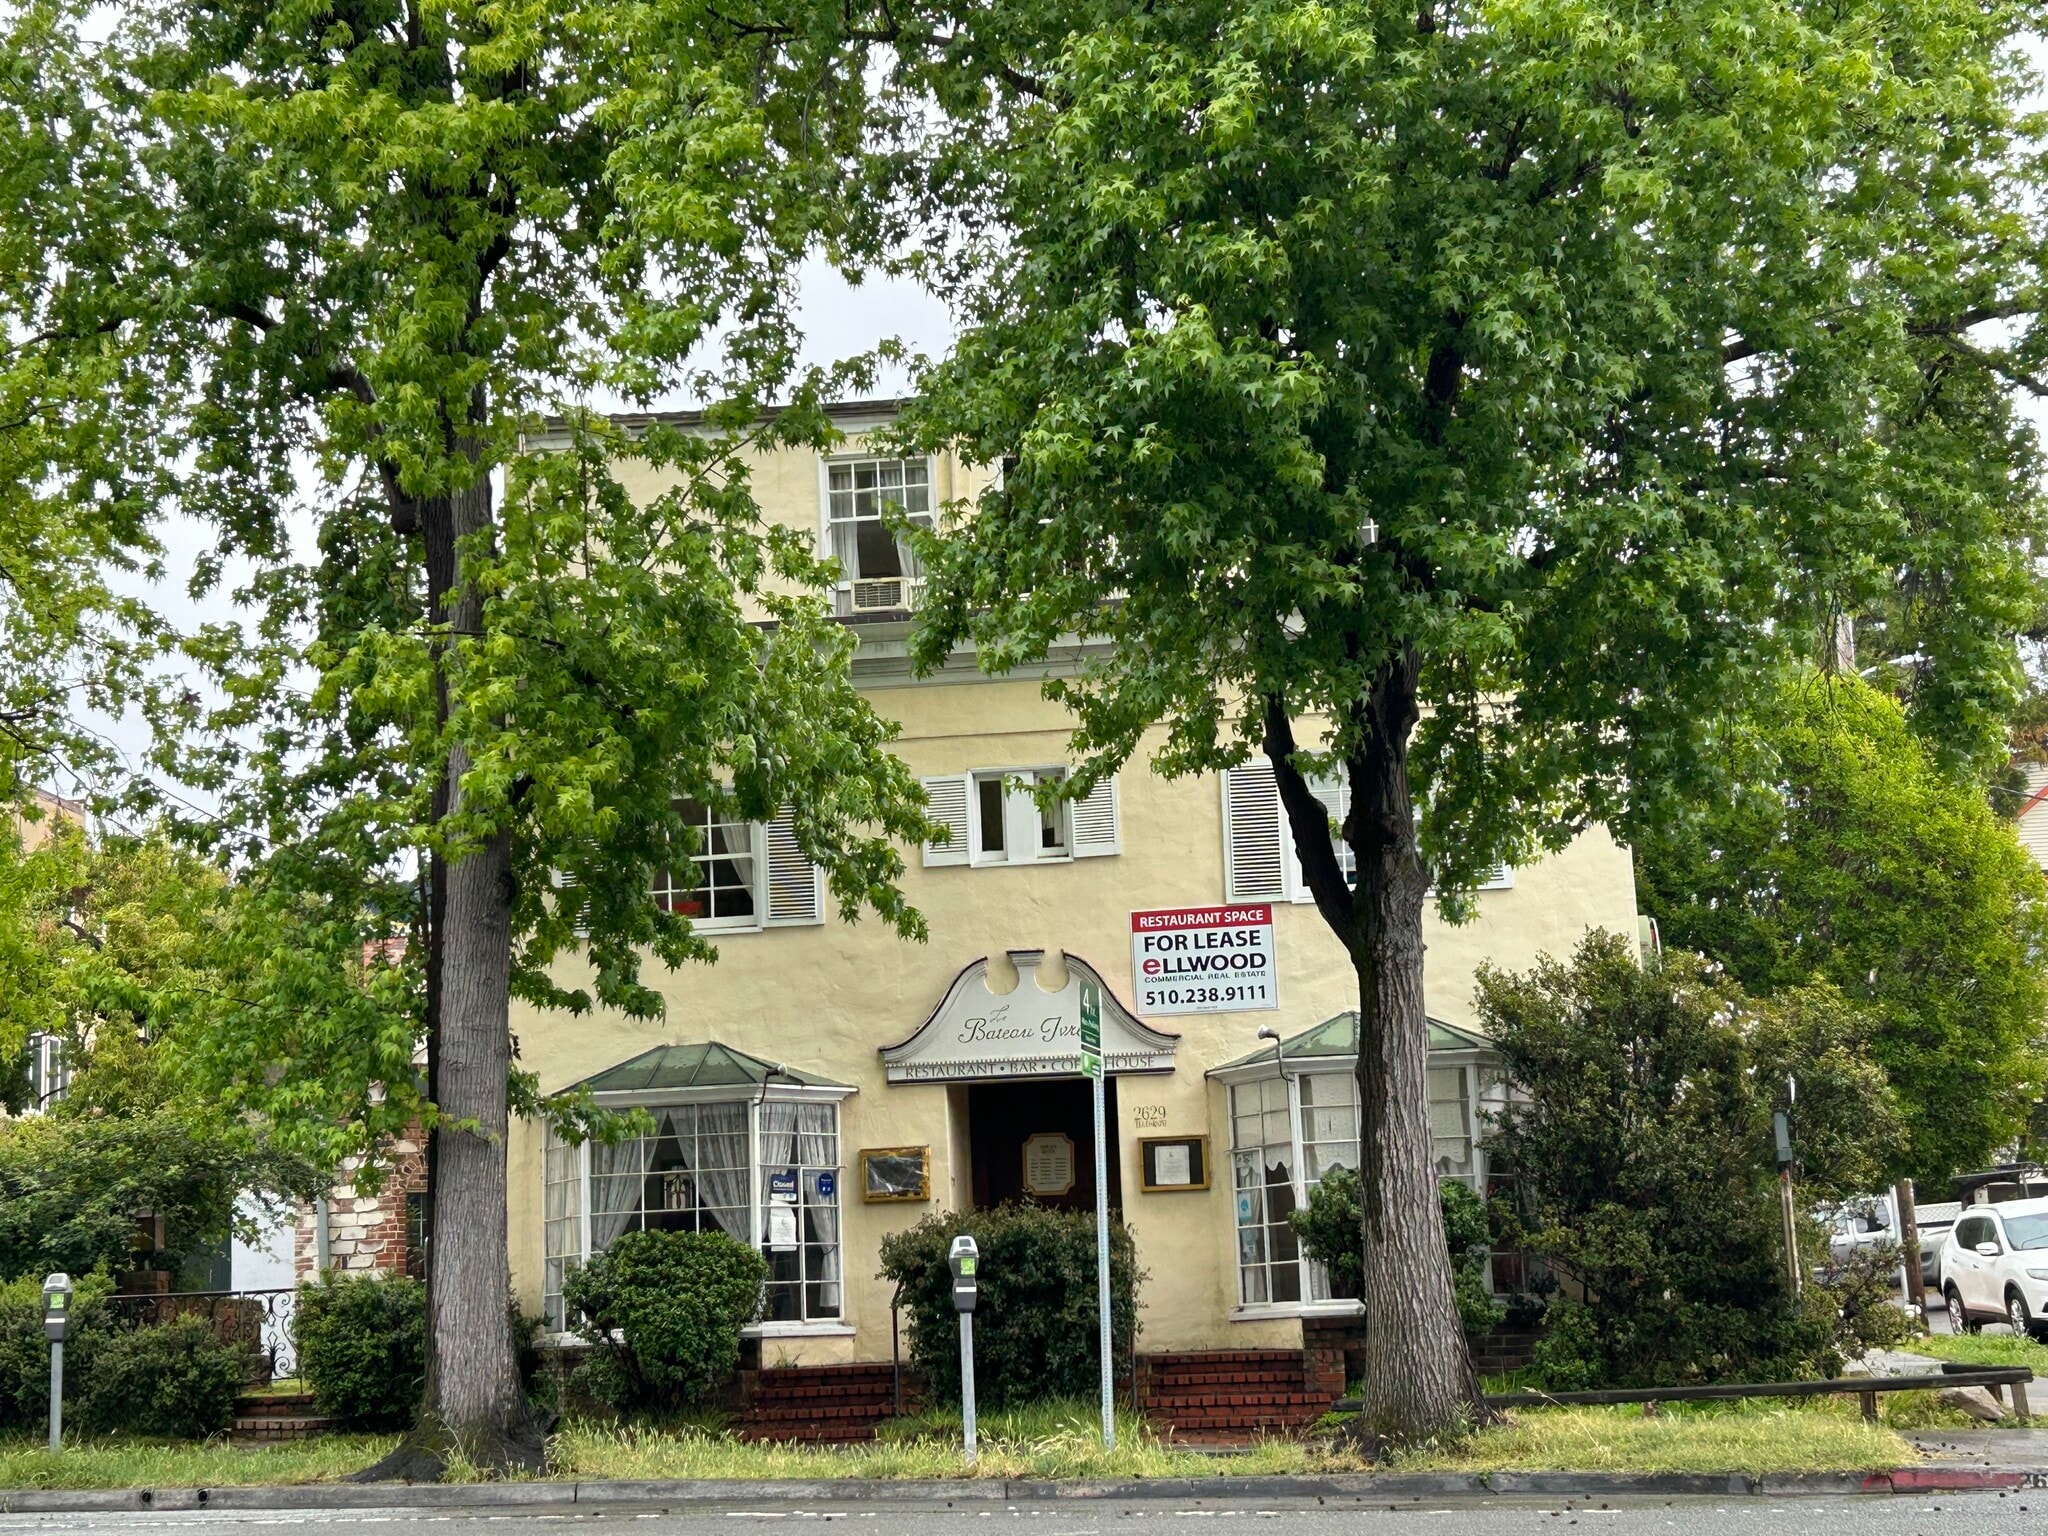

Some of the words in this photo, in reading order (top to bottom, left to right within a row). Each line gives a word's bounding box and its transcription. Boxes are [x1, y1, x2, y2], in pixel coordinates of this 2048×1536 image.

[1139, 912, 1222, 928] RESTAURANT
[1224, 909, 1264, 923] SPACE
[1144, 934, 1189, 953] FOR
[1194, 930, 1262, 950] LEASE
[1144, 974, 1204, 984] COMMERCIAL
[1234, 970, 1267, 979] ESTATE
[1082, 988, 1090, 1014] 4
[1145, 985, 1267, 1006] 510.238.9111
[957, 1017, 1035, 1043] Bateau
[905, 1063, 996, 1079] RESTAURANT
[1010, 1062, 1038, 1073] BAR
[1104, 1057, 1155, 1069] HOUSE
[1133, 1105, 1166, 1120] 2629
